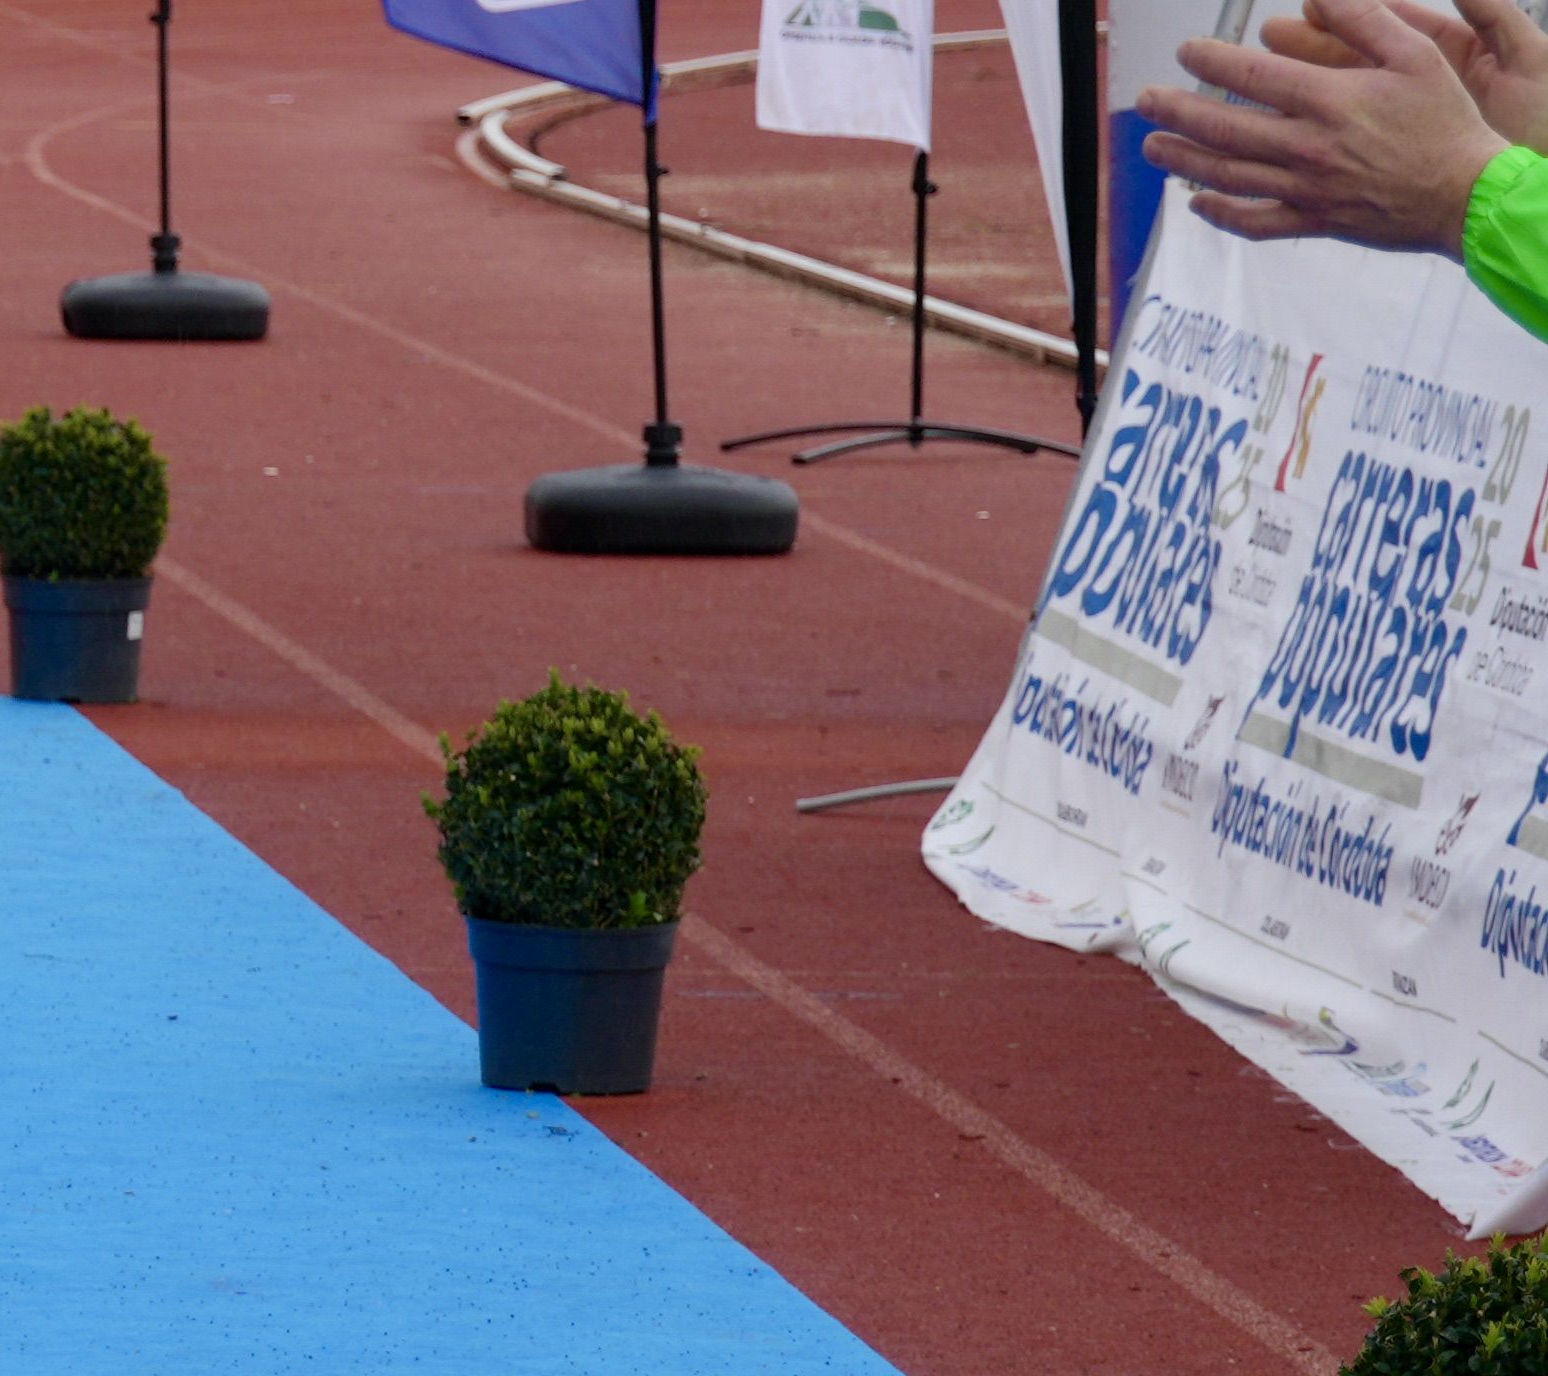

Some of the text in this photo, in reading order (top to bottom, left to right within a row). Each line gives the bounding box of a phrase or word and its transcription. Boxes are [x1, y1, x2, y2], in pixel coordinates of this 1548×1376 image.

[1483, 404, 1531, 506] 20
[1311, 450, 1476, 621] carreras
[1449, 513, 1503, 617] 25
[1235, 573, 1468, 762] populares
[1211, 758, 1394, 908] Diputación de Córdoba
